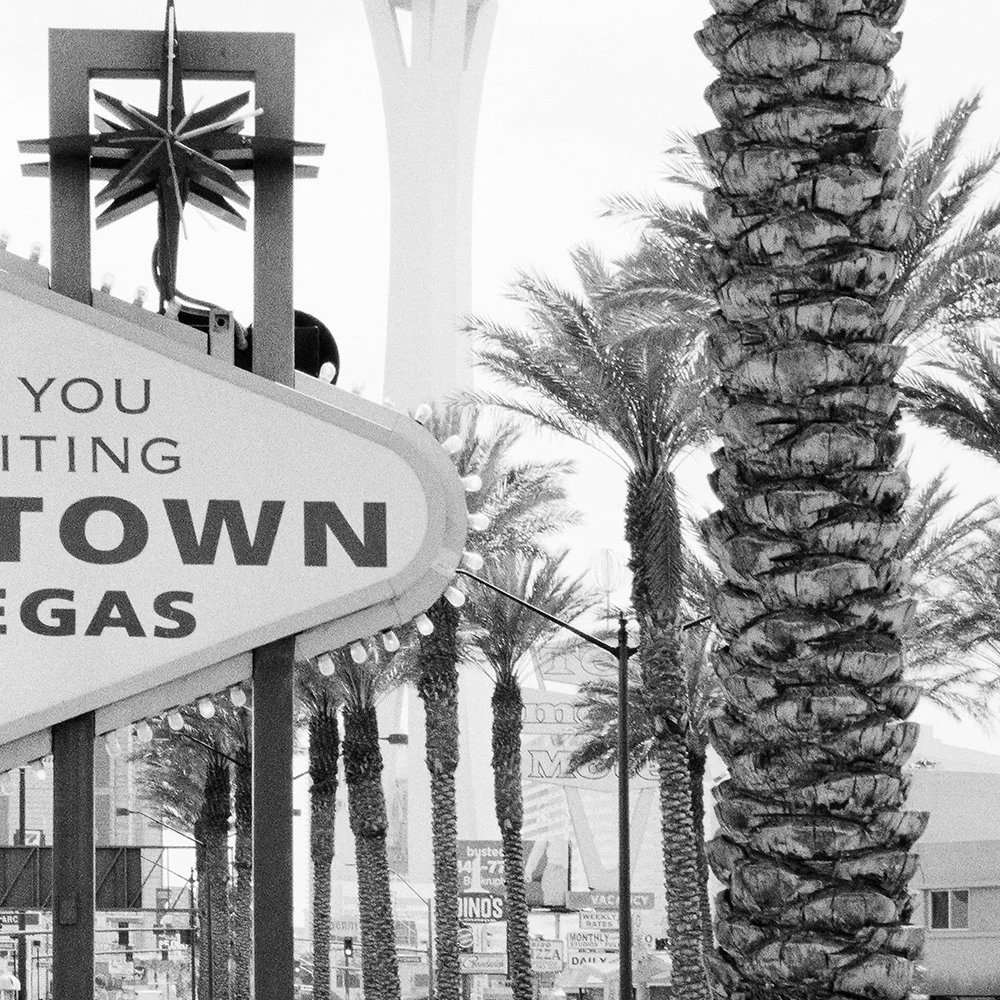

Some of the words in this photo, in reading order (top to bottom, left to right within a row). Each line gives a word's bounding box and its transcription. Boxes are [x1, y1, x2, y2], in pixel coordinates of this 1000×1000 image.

[17, 376, 151, 415] YOU
[583, 912, 617, 920] WEEKLY
[569, 932, 609, 943] MONTHLY
